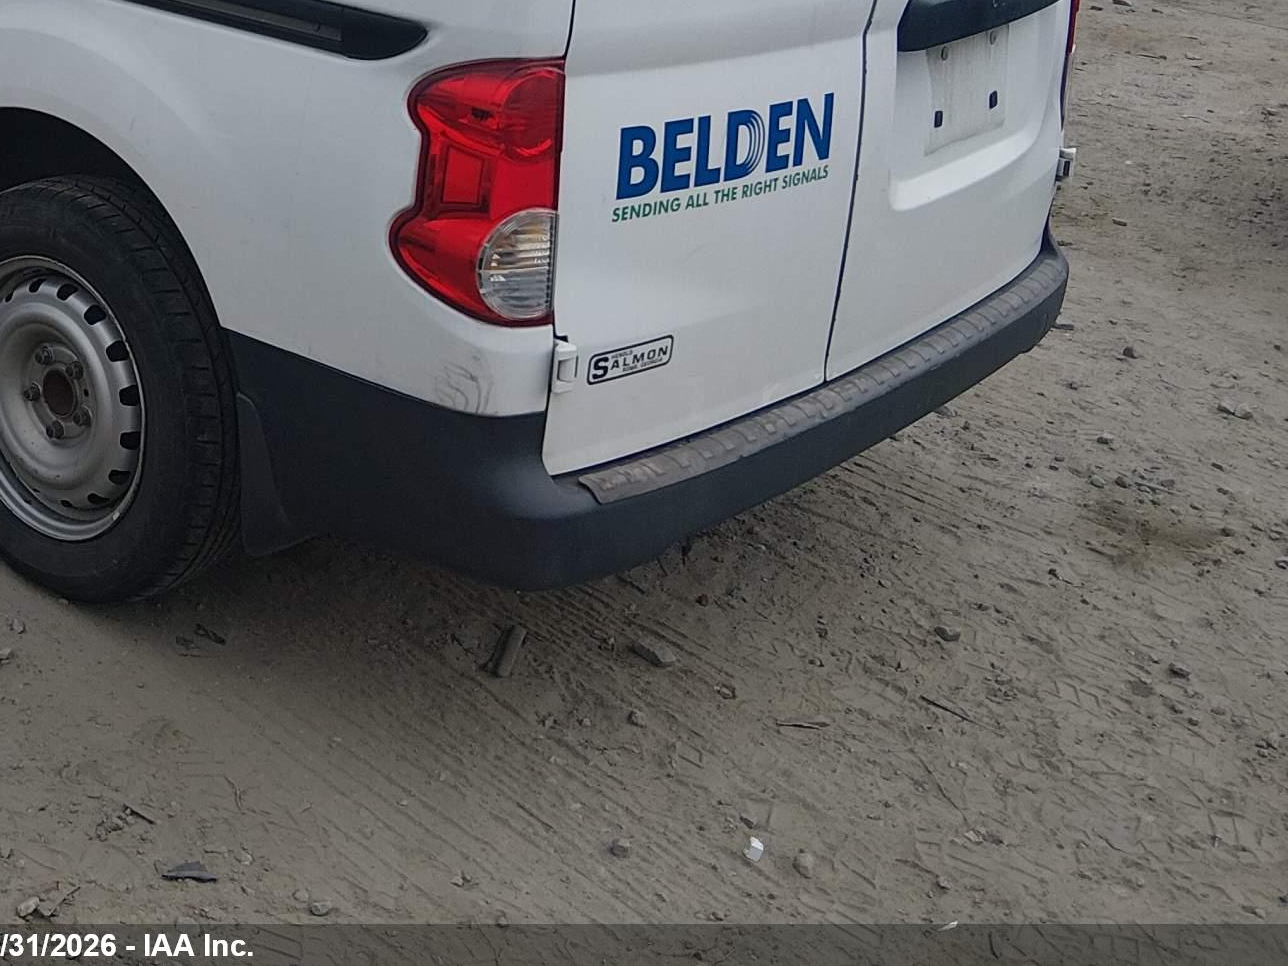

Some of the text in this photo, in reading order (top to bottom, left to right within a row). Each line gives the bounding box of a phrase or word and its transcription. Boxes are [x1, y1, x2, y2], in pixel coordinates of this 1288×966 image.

[616, 92, 835, 200] BELDEN
[612, 164, 830, 223] SENDING ALL THE RIGHT SIGNALS
[592, 346, 668, 380] SALMON
